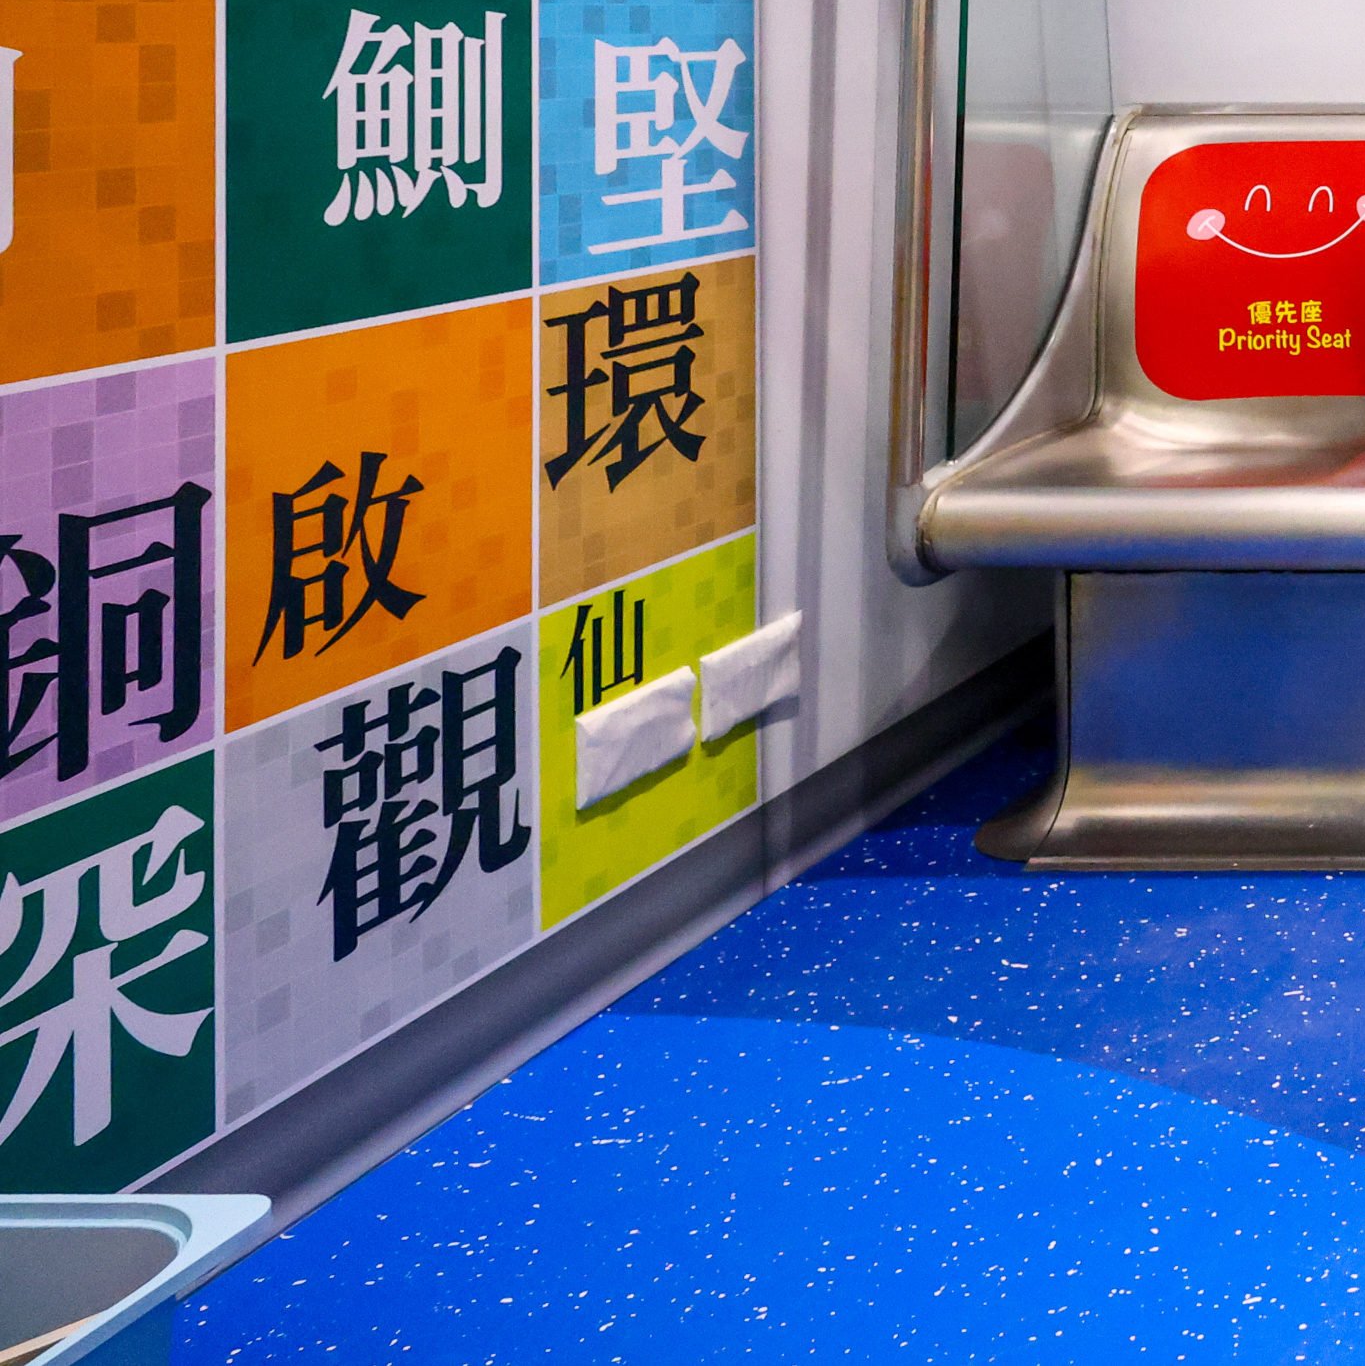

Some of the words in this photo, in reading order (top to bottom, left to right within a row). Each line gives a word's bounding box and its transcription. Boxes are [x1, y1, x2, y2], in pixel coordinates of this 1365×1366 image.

[322, 8, 507, 227] 鰂
[587, 37, 750, 255] 堅
[543, 272, 707, 493] 環
[1218, 326, 1301, 355] Priority
[1306, 326, 1352, 350] Seat
[1247, 300, 1323, 325] 優先座
[253, 450, 428, 669] 啟
[560, 588, 646, 715] 仙
[315, 645, 532, 963] 觀
